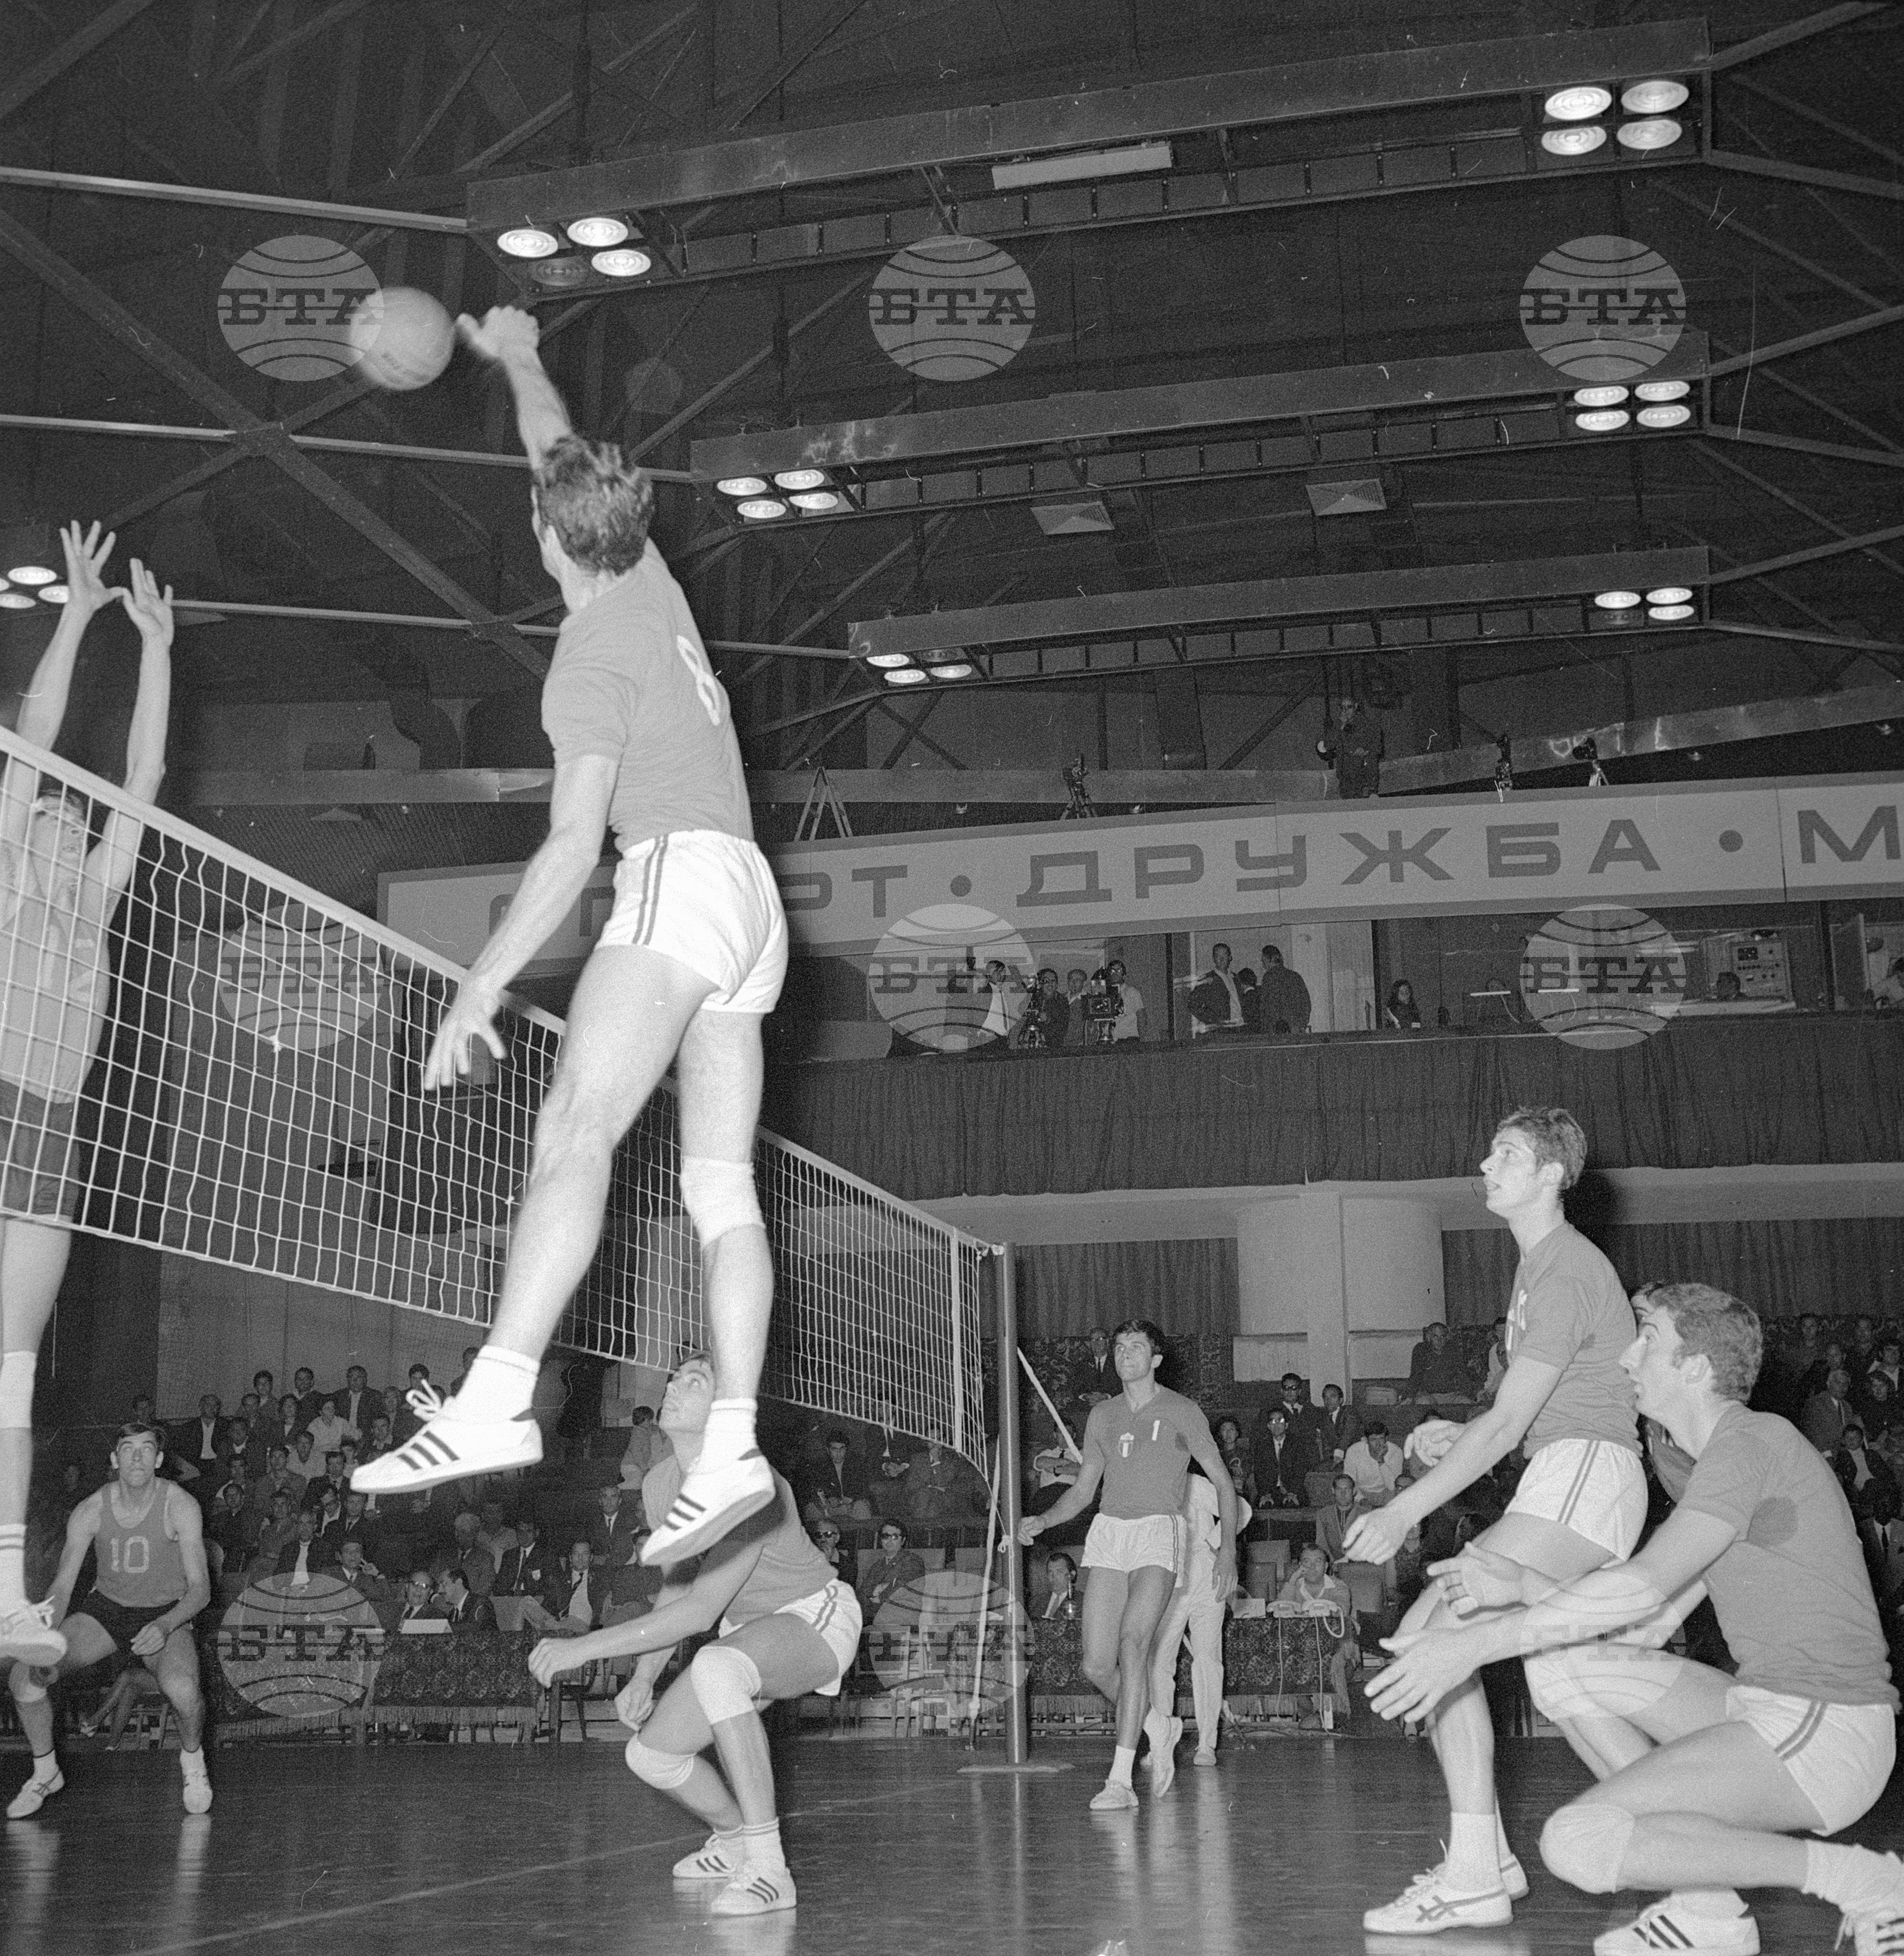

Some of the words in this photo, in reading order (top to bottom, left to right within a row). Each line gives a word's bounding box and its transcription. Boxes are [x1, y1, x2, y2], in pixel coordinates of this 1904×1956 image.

[676, 635, 721, 726] 8
[1017, 819, 1661, 908] ДРУЖБА
[1797, 805, 1901, 864] М
[1151, 1420, 1160, 1441] 1
[110, 1536, 149, 1574] 10
